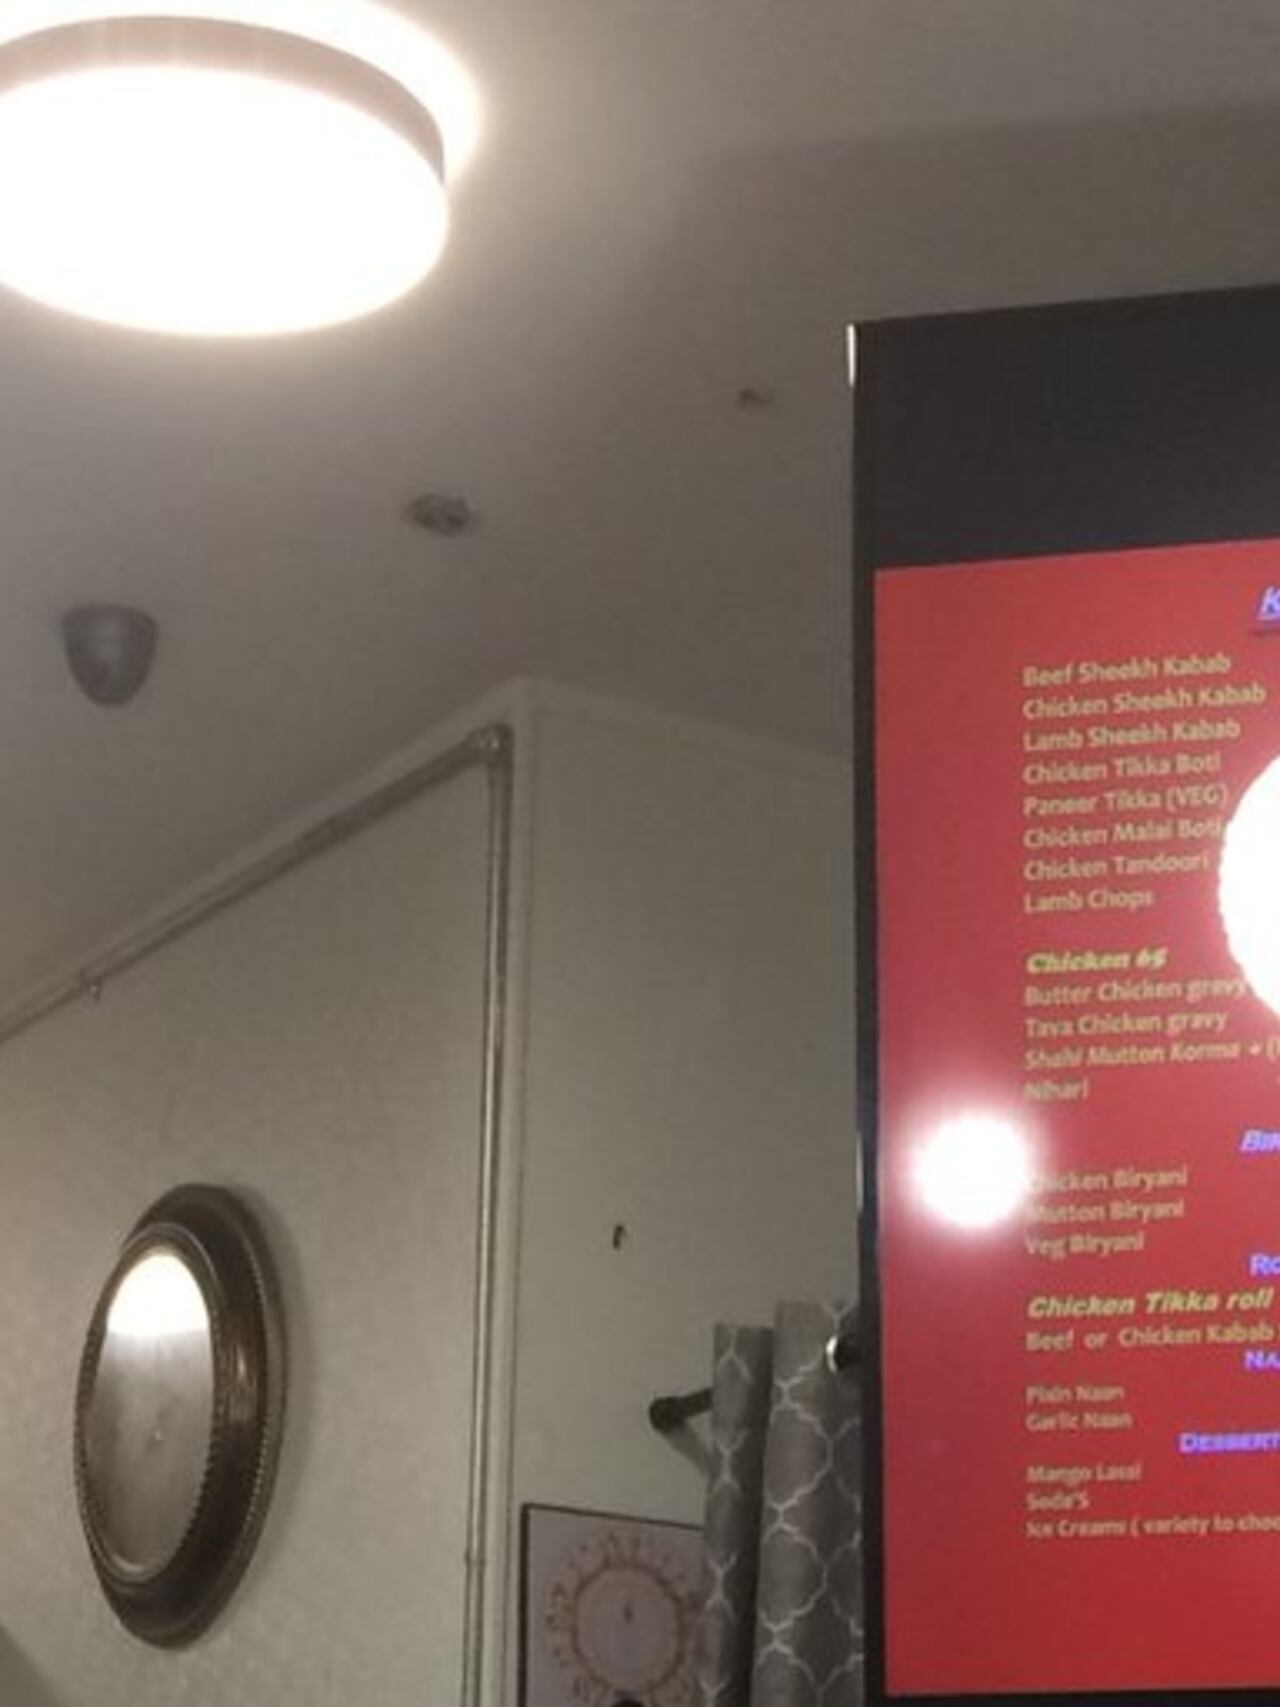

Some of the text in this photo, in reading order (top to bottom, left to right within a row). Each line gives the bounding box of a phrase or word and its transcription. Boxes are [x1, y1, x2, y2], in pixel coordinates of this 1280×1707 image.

[1022, 663, 1072, 687] Beef
[1078, 658, 1158, 682] Sheekh
[1161, 653, 1231, 677] Kabab
[1023, 695, 1108, 720] Chicken
[1114, 690, 1195, 715] Sheekh
[1199, 683, 1266, 708] Kabab
[1024, 728, 1083, 751] Lamb
[1088, 723, 1167, 748] Sheekh
[1173, 718, 1241, 742] Kabab
[1024, 762, 1108, 785] Chicken
[1114, 757, 1170, 778] Tikka
[1175, 752, 1221, 774] Boti
[1024, 796, 1097, 817] Paneer
[1105, 791, 1161, 812] Tikka
[1166, 781, 1228, 812] (VEG)
[1024, 828, 1108, 850] Chicken
[1113, 822, 1172, 844] Malai
[1024, 853, 1208, 883] Chicken Tandoori
[1024, 888, 1156, 914] Lamb Chops
[1026, 951, 1131, 975] Chicken
[1025, 984, 1092, 1006] Butter
[1097, 977, 1184, 1002] Chicken
[1186, 978, 1246, 1004] gravy
[1078, 1010, 1163, 1034] Chicken
[1166, 1009, 1229, 1034] gravy
[1087, 1044, 1166, 1067] Mutton
[1169, 1041, 1240, 1063] Korma
[1025, 1080, 1090, 1102] Nihari
[1112, 1164, 1188, 1190] Biryani
[1109, 1198, 1185, 1223] Biryani
[1024, 1230, 1145, 1261] Veg Biryani
[1027, 1295, 1136, 1319] Chicken
[1144, 1290, 1220, 1314] Tikka
[1226, 1287, 1275, 1312] roll
[1025, 1329, 1074, 1351] Beef
[1084, 1332, 1108, 1348] or
[1119, 1326, 1201, 1347] Chicken
[1206, 1322, 1275, 1344] Kabab
[1026, 1386, 1072, 1405] Plain
[1076, 1385, 1124, 1402] Naan
[1026, 1413, 1078, 1432] Garlic
[1083, 1412, 1133, 1430] Naan
[1026, 1466, 1090, 1486] Mango
[1095, 1462, 1141, 1482] Lassi
[1026, 1521, 1053, 1538] Ice
[1143, 1515, 1210, 1536] variety
[1213, 1515, 1234, 1532] to
